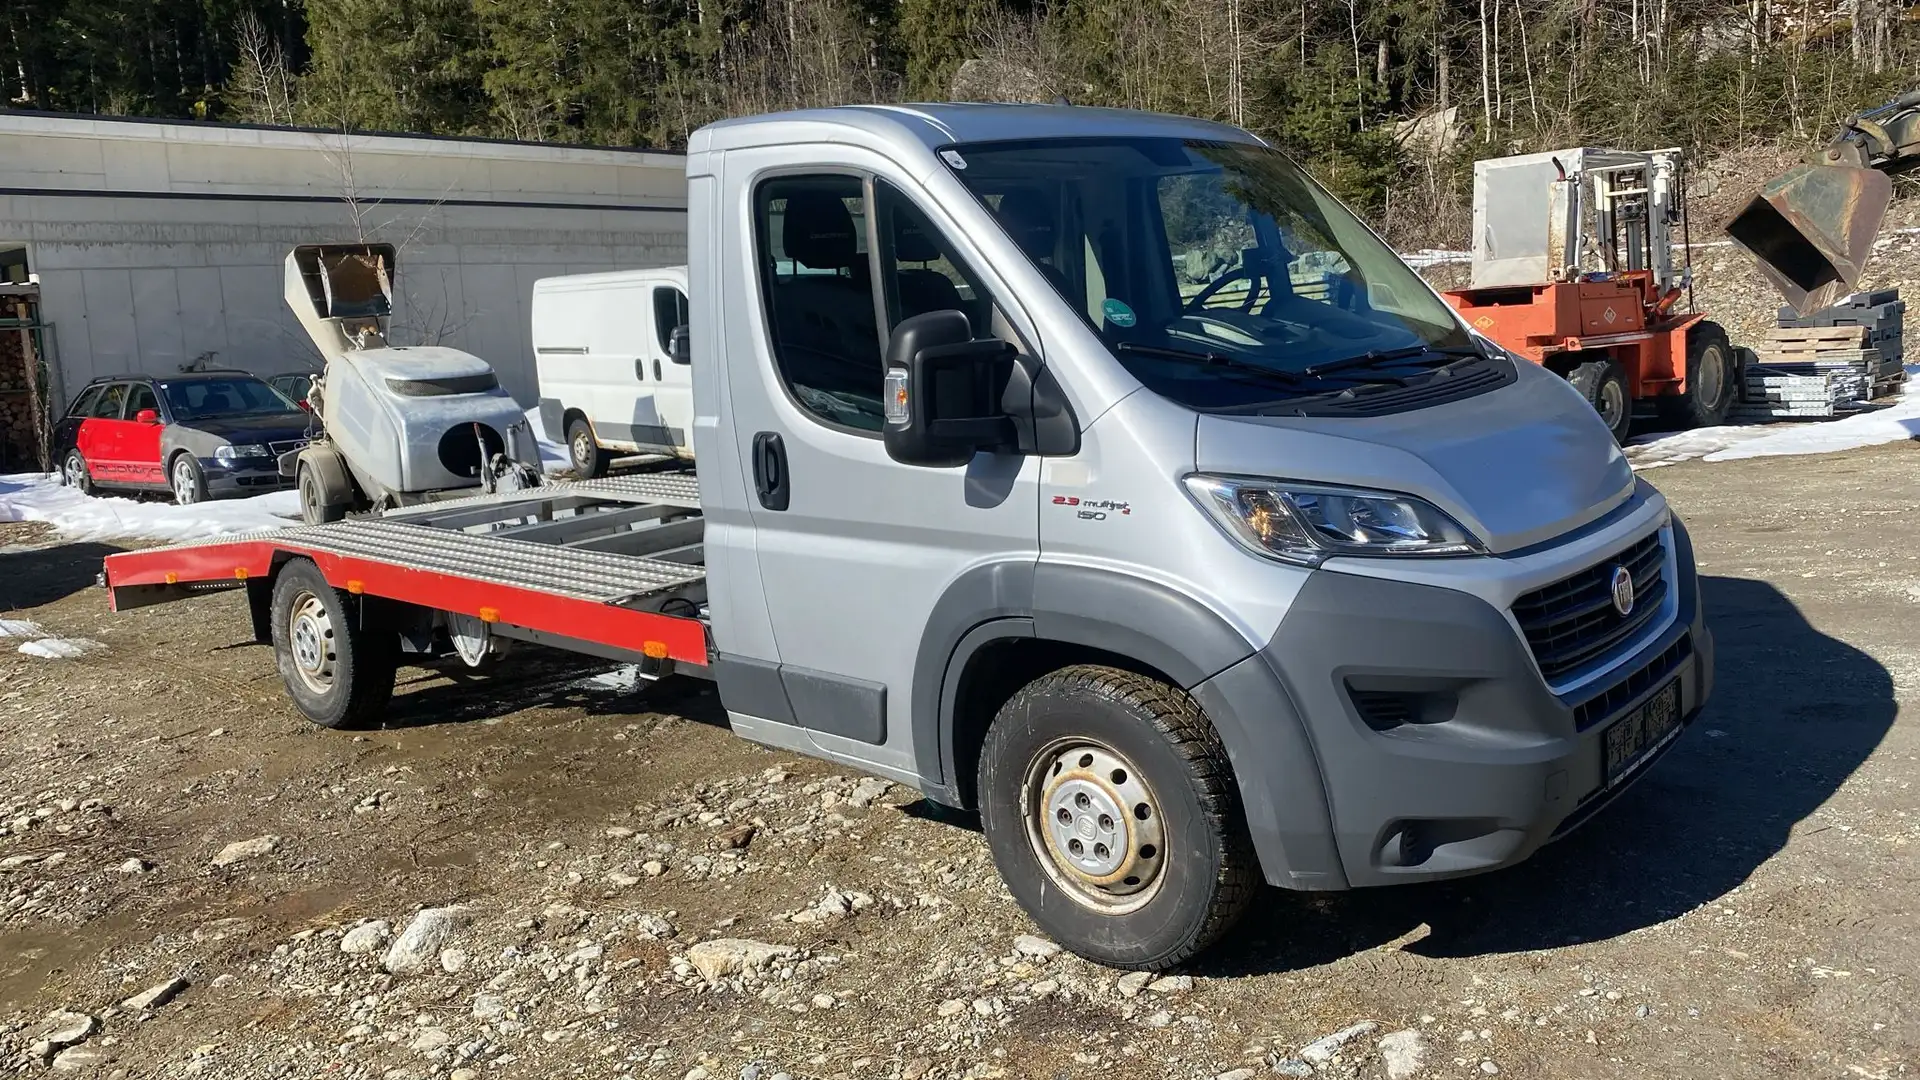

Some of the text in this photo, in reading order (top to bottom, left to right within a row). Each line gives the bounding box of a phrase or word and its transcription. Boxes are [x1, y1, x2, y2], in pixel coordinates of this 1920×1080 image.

[96, 464, 162, 476] quattro
[1052, 496, 1080, 506] 2.3
[1077, 510, 1107, 521] 150
